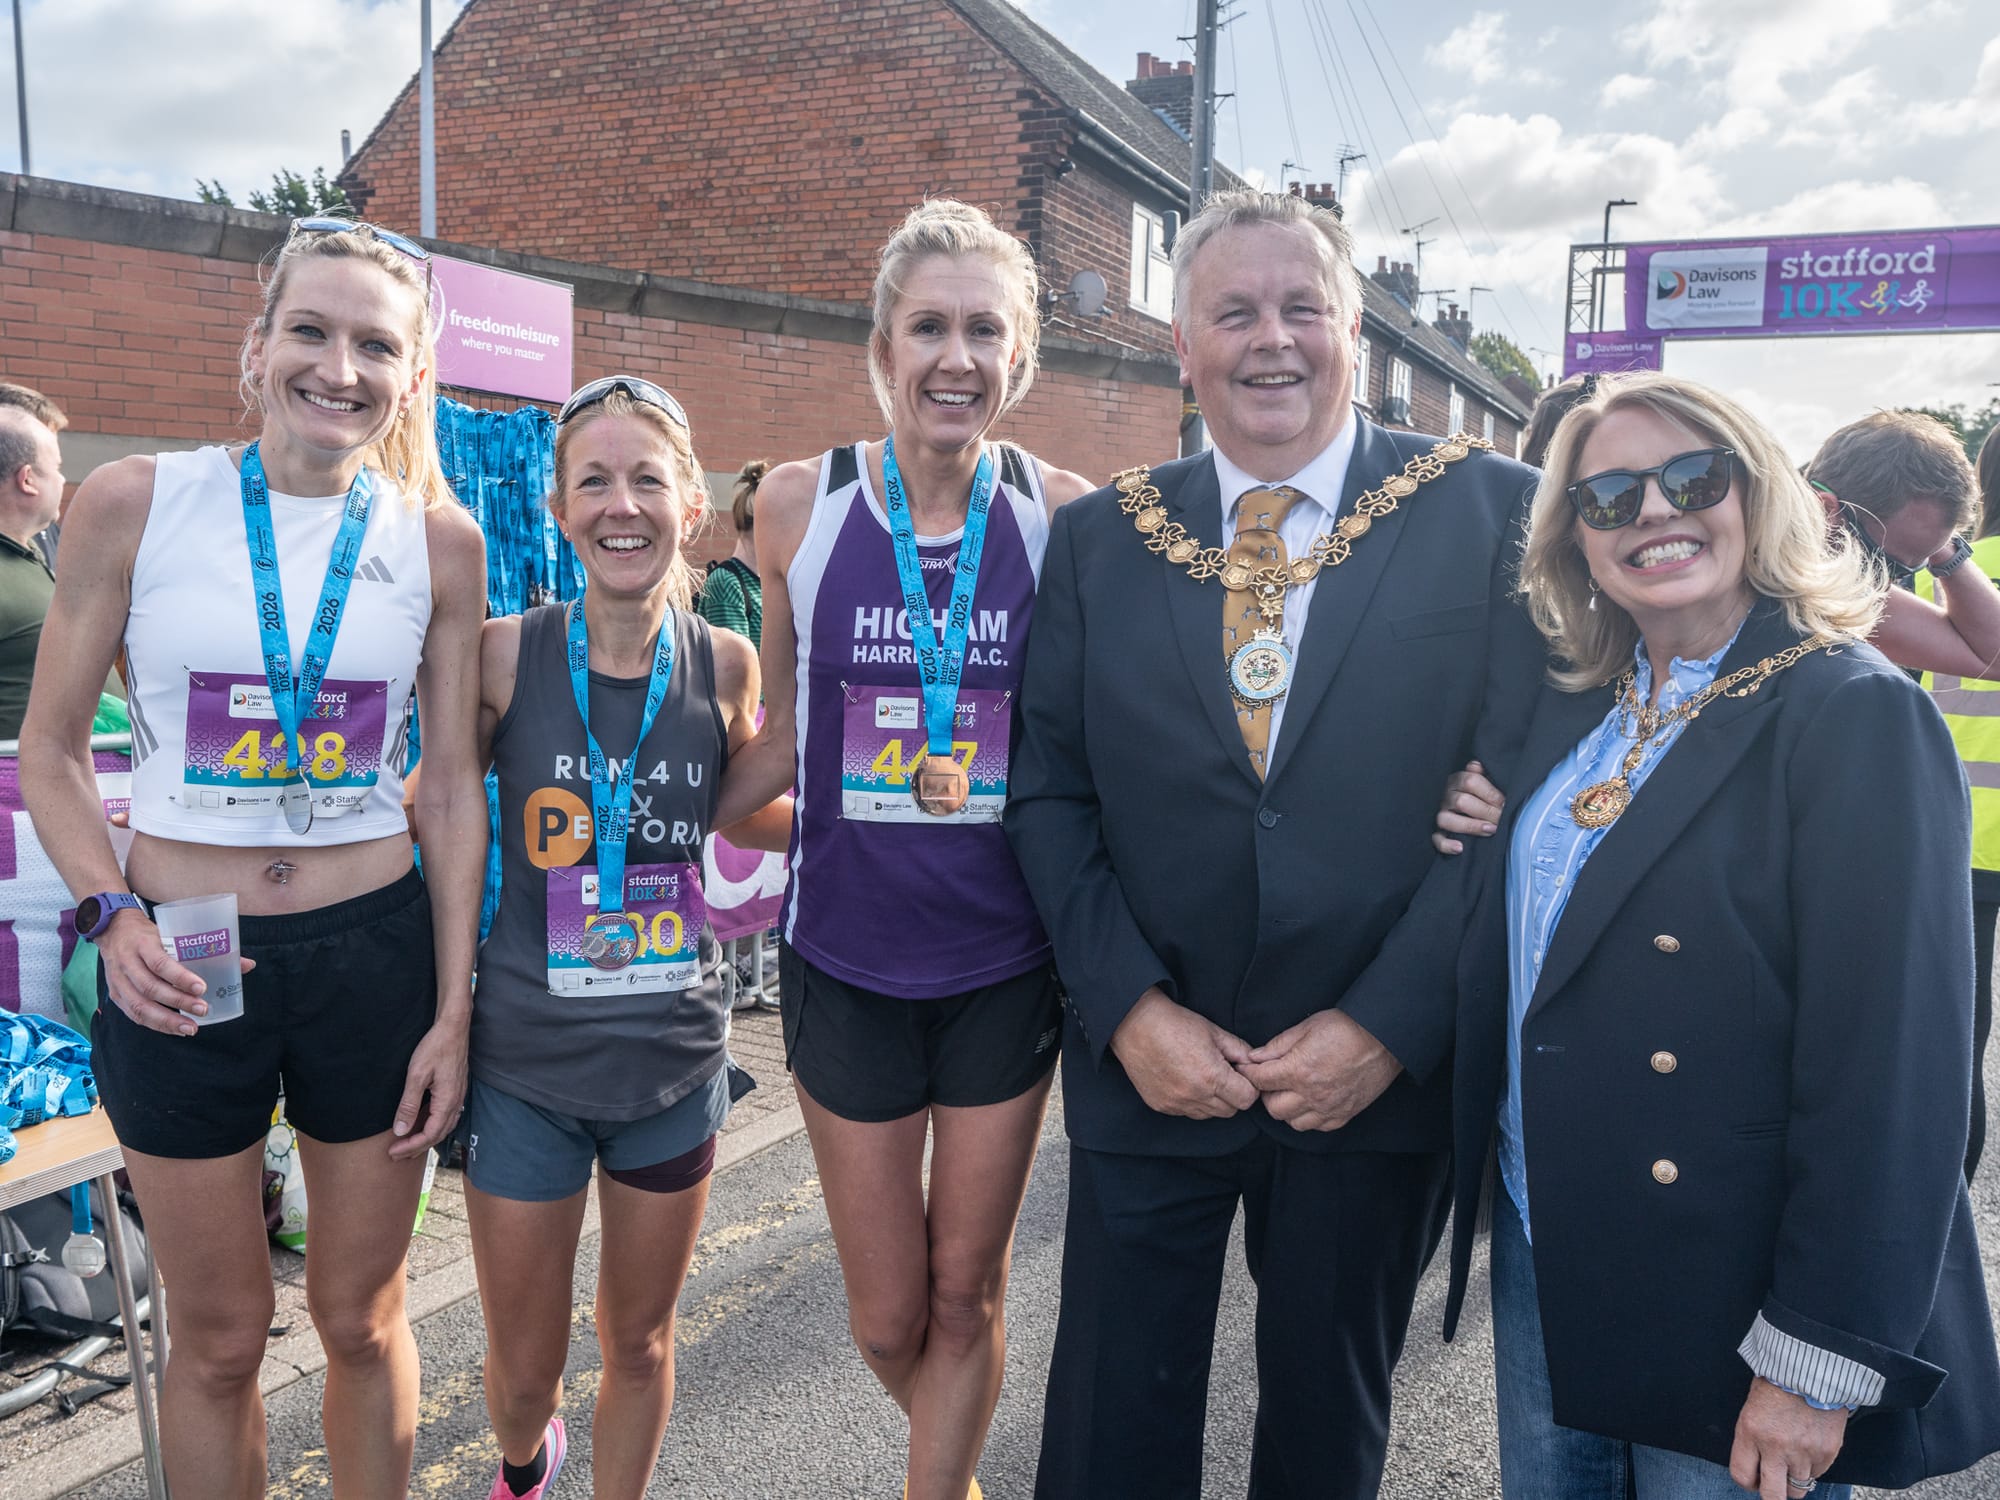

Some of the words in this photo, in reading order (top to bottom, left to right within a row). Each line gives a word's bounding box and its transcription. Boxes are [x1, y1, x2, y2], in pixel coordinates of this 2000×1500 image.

[1780, 245, 1936, 279] stafford
[1689, 267, 1757, 283] Davisons
[1688, 286, 1720, 299] Law
[1778, 281, 1864, 319] 10K
[450, 309, 560, 347] freedomleisure
[461, 335, 492, 351] where
[494, 343, 513, 356] you
[514, 347, 546, 361] matter
[1594, 343, 1633, 353] Davisons
[1635, 342, 1655, 352] Law
[255, 487, 266, 506] 10K
[887, 477, 903, 511] 2026
[978, 495, 989, 515] 10K
[261, 592, 281, 631] 2026
[905, 592, 918, 613] 10K
[916, 591, 930, 627] stafford
[952, 593, 970, 630] 2026
[317, 598, 340, 635] 2026
[578, 653, 586, 672] 10K
[656, 643, 671, 676] 2026
[919, 647, 938, 685] 2026
[939, 648, 950, 685] stafford
[967, 650, 1009, 666] A.C.
[265, 653, 280, 694] stafford
[278, 669, 290, 694] 10K
[301, 654, 315, 693] stafford
[308, 671, 324, 696] 10K
[947, 664, 960, 686] 10K
[248, 692, 272, 701] Daviso
[223, 730, 347, 781] 428
[648, 760, 670, 785] 4
[687, 762, 702, 788] U
[630, 778, 653, 819] &
[608, 807, 619, 843] stafford
[615, 822, 626, 843] 10K
[628, 873, 679, 886] stafford
[628, 886, 657, 901] 10K
[178, 930, 227, 947] stafford
[605, 925, 620, 934] 10K
[181, 945, 208, 960] 10K
